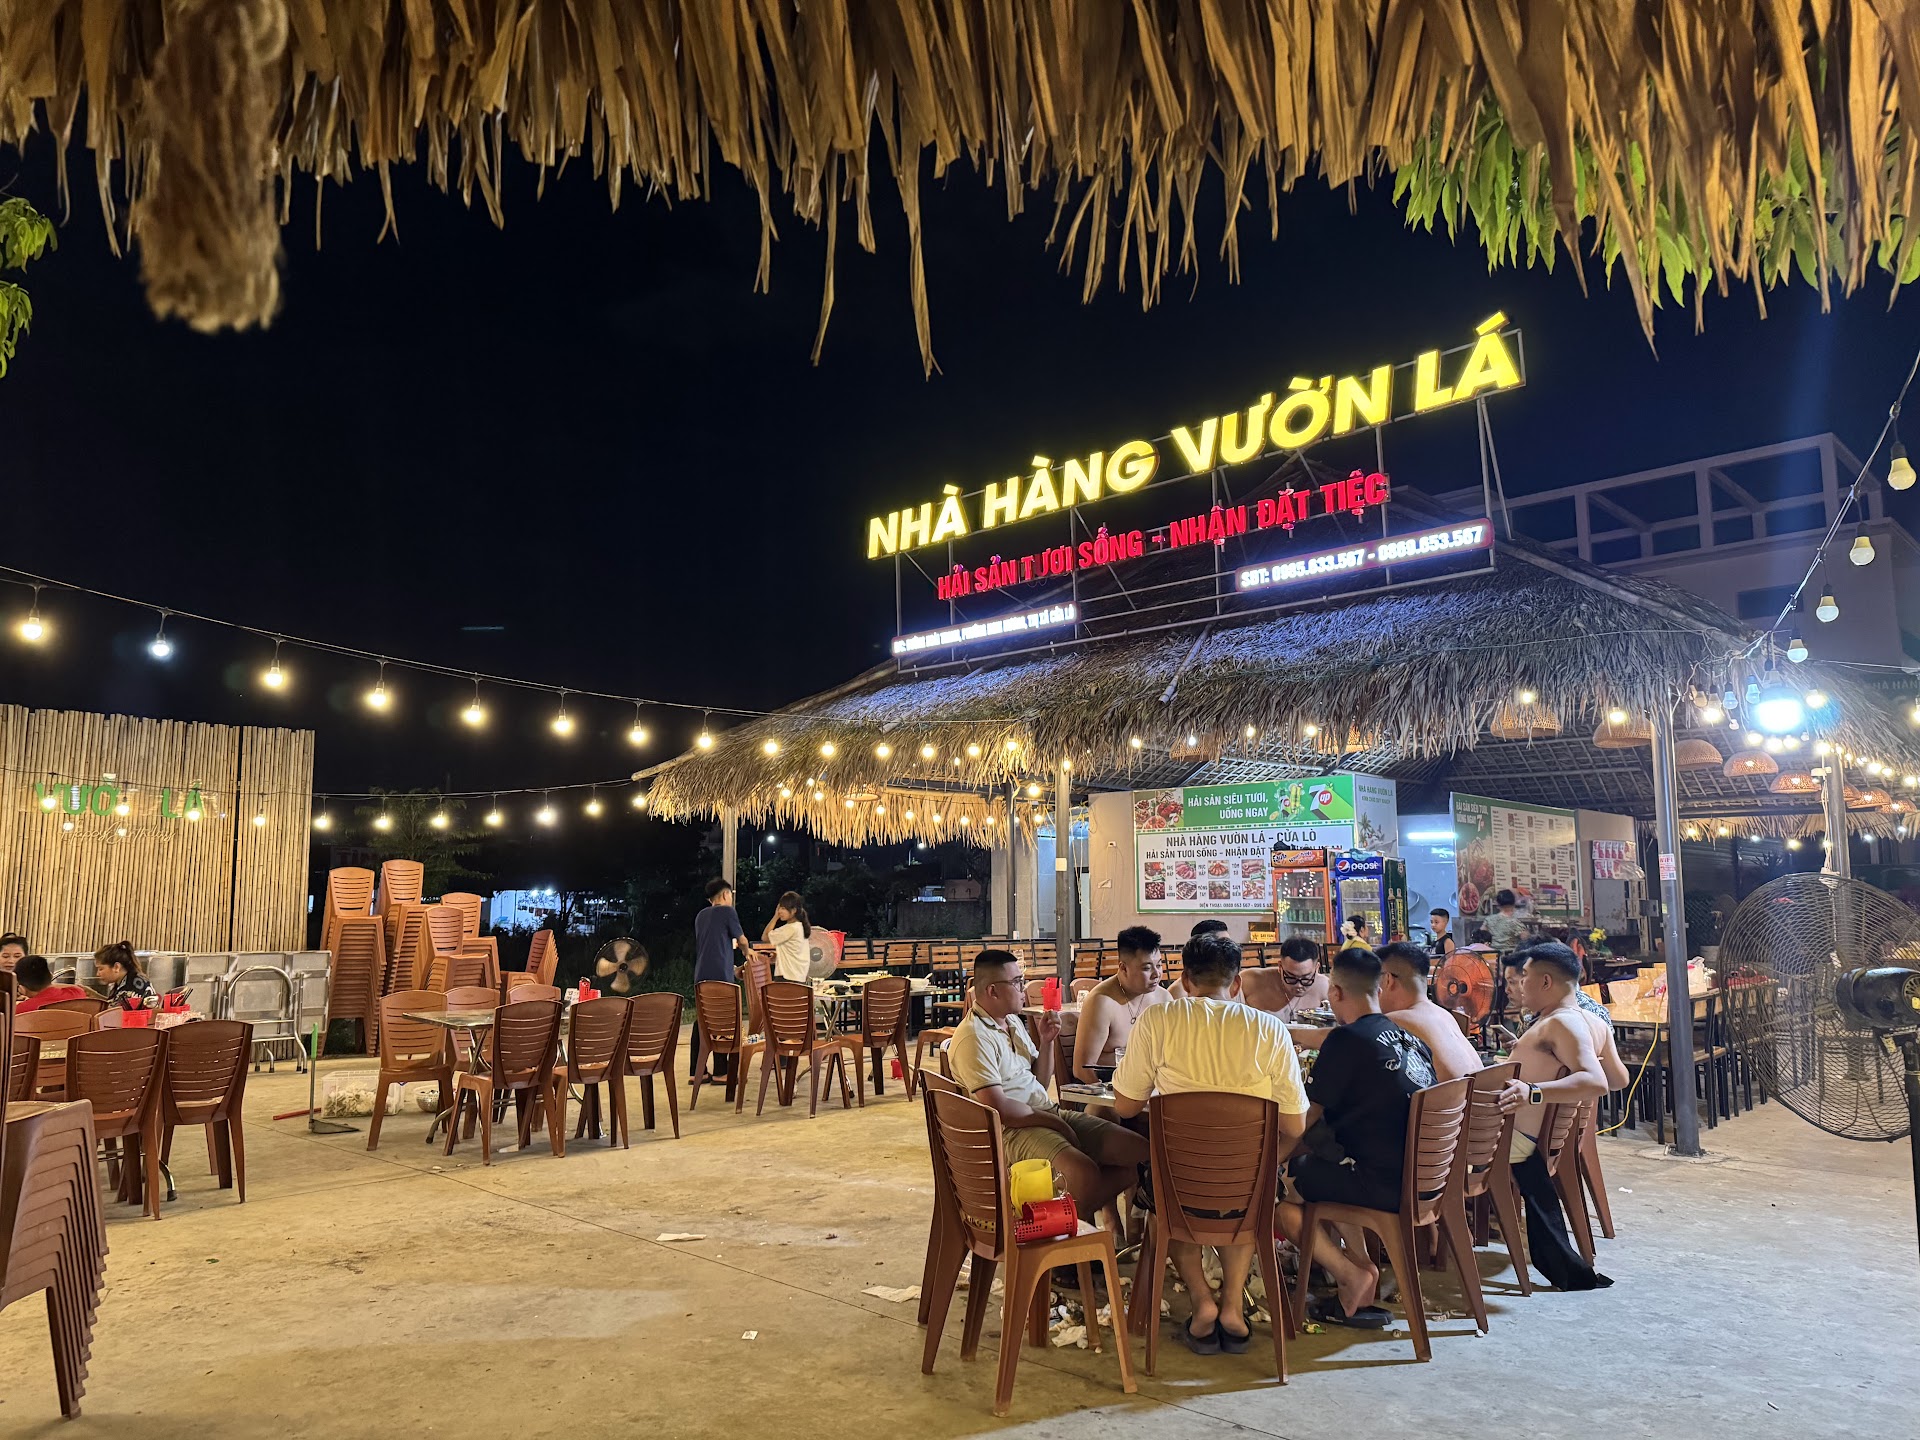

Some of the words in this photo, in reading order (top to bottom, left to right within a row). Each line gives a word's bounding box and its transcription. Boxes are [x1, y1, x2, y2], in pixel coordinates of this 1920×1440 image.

[867, 484, 971, 560] NHÀ
[982, 440, 1161, 530] HÀNG
[1170, 363, 1395, 474] VƯỜN
[1414, 311, 1524, 414] LÁ
[937, 563, 971, 600] HẢI
[974, 553, 1018, 592] SẢN
[1169, 505, 1247, 549] NHẬN
[1256, 488, 1311, 531] ĐẶT
[1319, 468, 1389, 516] TIỆC
[1188, 795, 1202, 807] HẢI
[1204, 793, 1222, 806] SẢN
[1223, 792, 1243, 805] SIÊU
[1245, 792, 1268, 804] TƯƠI,
[1219, 807, 1243, 819] UỐNG
[1245, 806, 1269, 818] NGAY
[103, 820, 176, 845] Brthday
[1166, 834, 1187, 847] NHÀ
[1189, 832, 1217, 846] HÀNG
[1219, 831, 1249, 845] VƯỜN
[1252, 830, 1266, 844] LÁ
[1276, 829, 1300, 842] CỬA
[1302, 828, 1317, 842] LÒ
[1146, 848, 1158, 859] HẢI
[1160, 847, 1176, 859] SẢN
[1196, 846, 1217, 858] SỐNG
[1225, 847, 1248, 859] NHẬN
